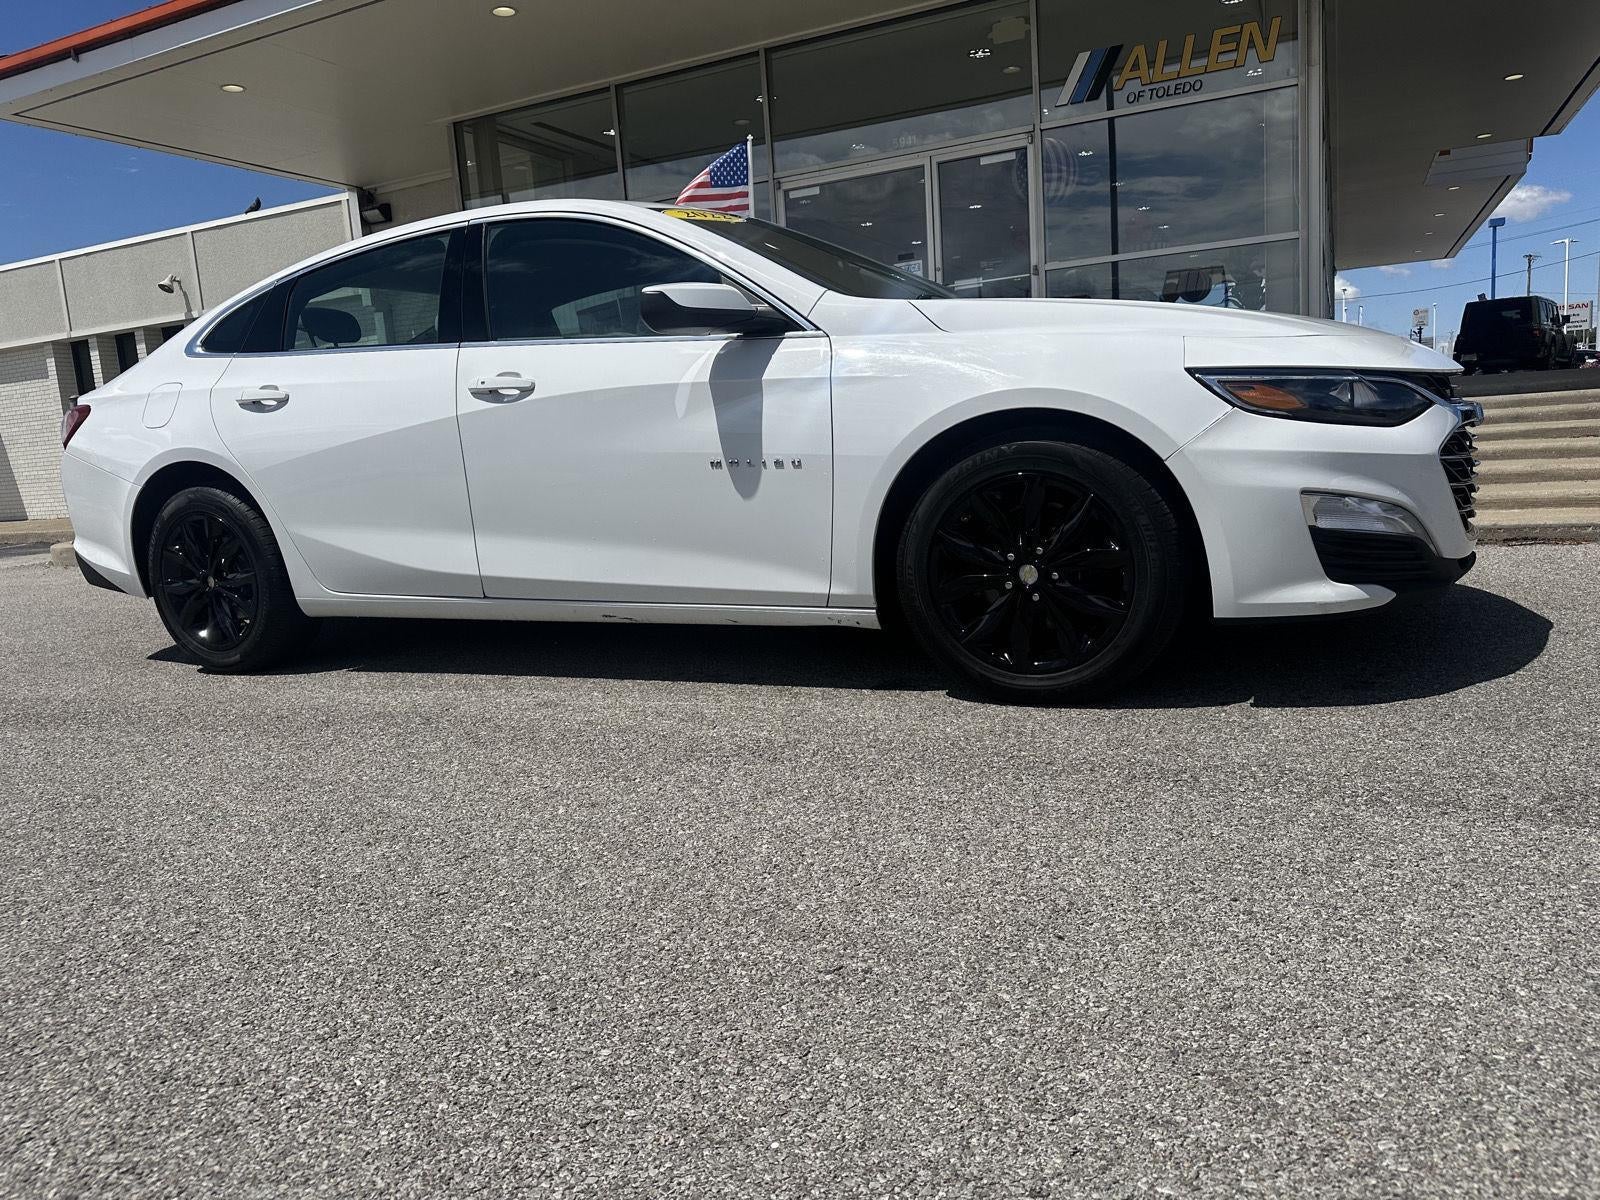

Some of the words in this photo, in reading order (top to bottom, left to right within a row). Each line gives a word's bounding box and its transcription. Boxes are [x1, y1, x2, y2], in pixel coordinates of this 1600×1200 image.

[1113, 15, 1283, 91] ALLEN
[1126, 90, 1145, 104] OF
[1148, 79, 1203, 100] TOLEDO
[1556, 302, 1589, 311] ISSAN
[709, 458, 803, 471] MALIBU
